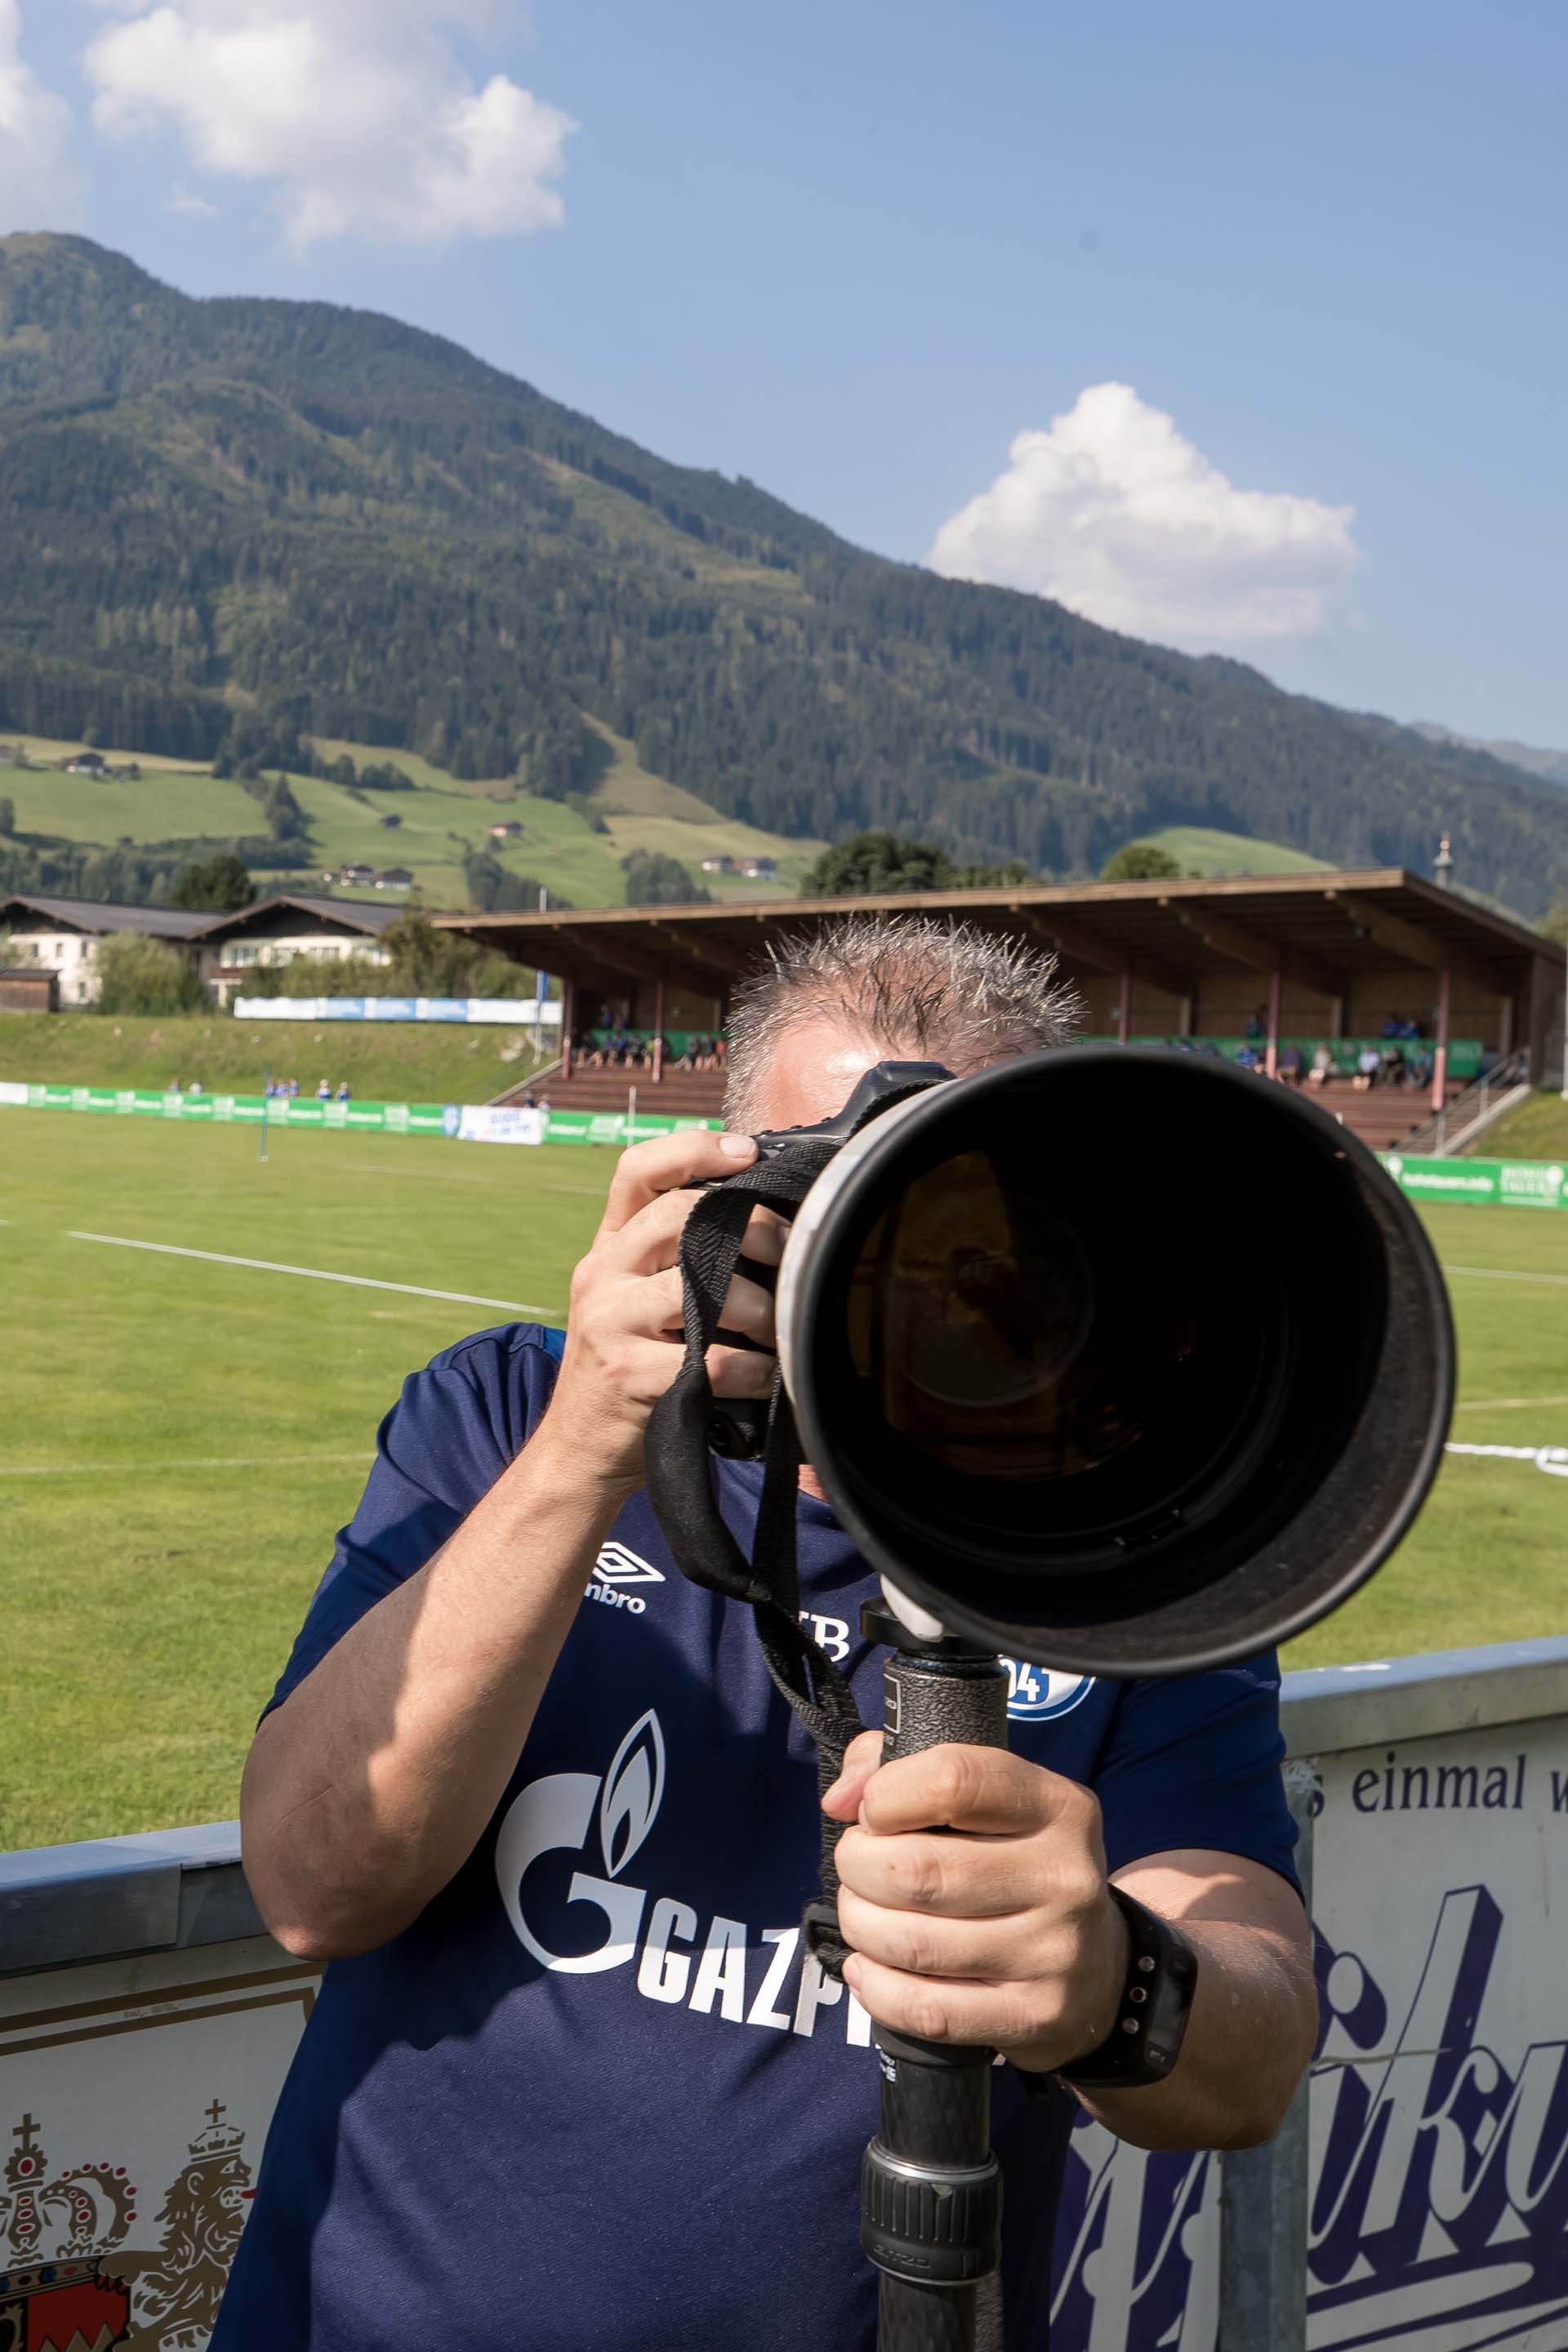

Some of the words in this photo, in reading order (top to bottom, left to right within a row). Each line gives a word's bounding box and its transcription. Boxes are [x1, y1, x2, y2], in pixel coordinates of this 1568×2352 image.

[798, 1610, 850, 1663] B
[1352, 1751, 1526, 1813] einmal
[637, 1897, 884, 2049] GAZP
